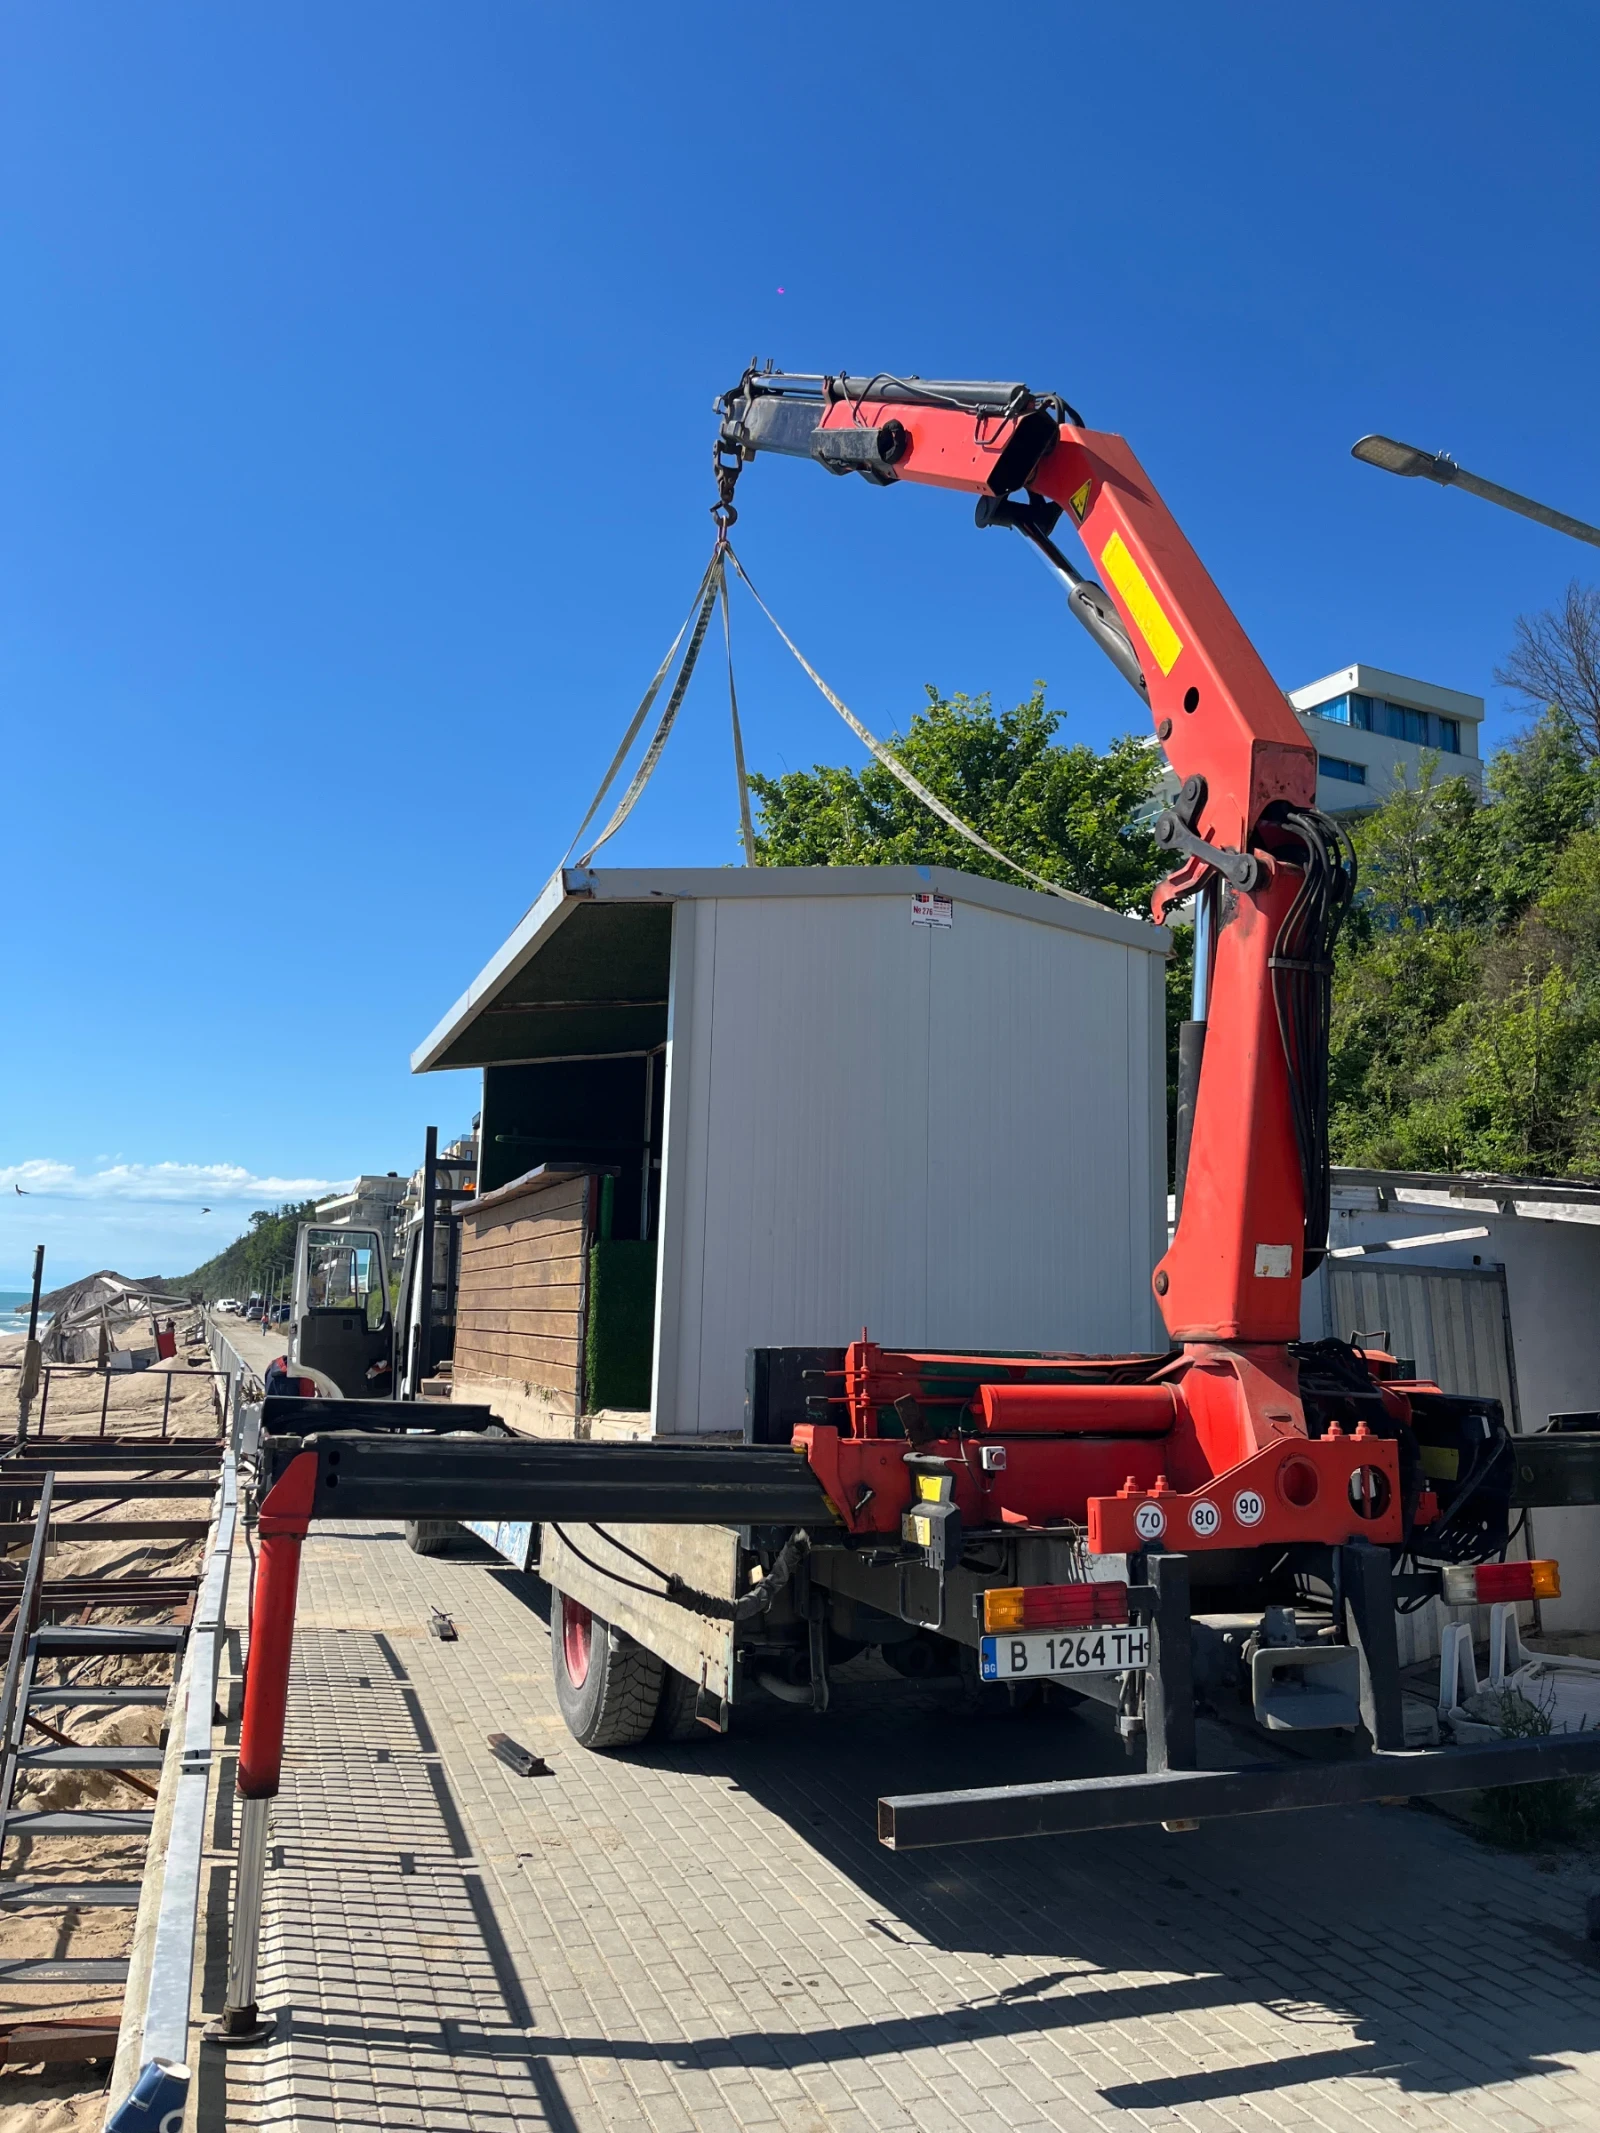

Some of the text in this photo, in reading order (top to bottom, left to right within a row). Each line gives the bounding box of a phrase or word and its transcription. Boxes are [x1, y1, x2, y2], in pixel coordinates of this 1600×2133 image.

[1239, 1498, 1259, 1514] 90
[1139, 1513, 1160, 1528] 70
[1194, 1510, 1215, 1525] 80
[1010, 1633, 1144, 1672] B 1264 TH
[984, 1664, 996, 1674] BG
